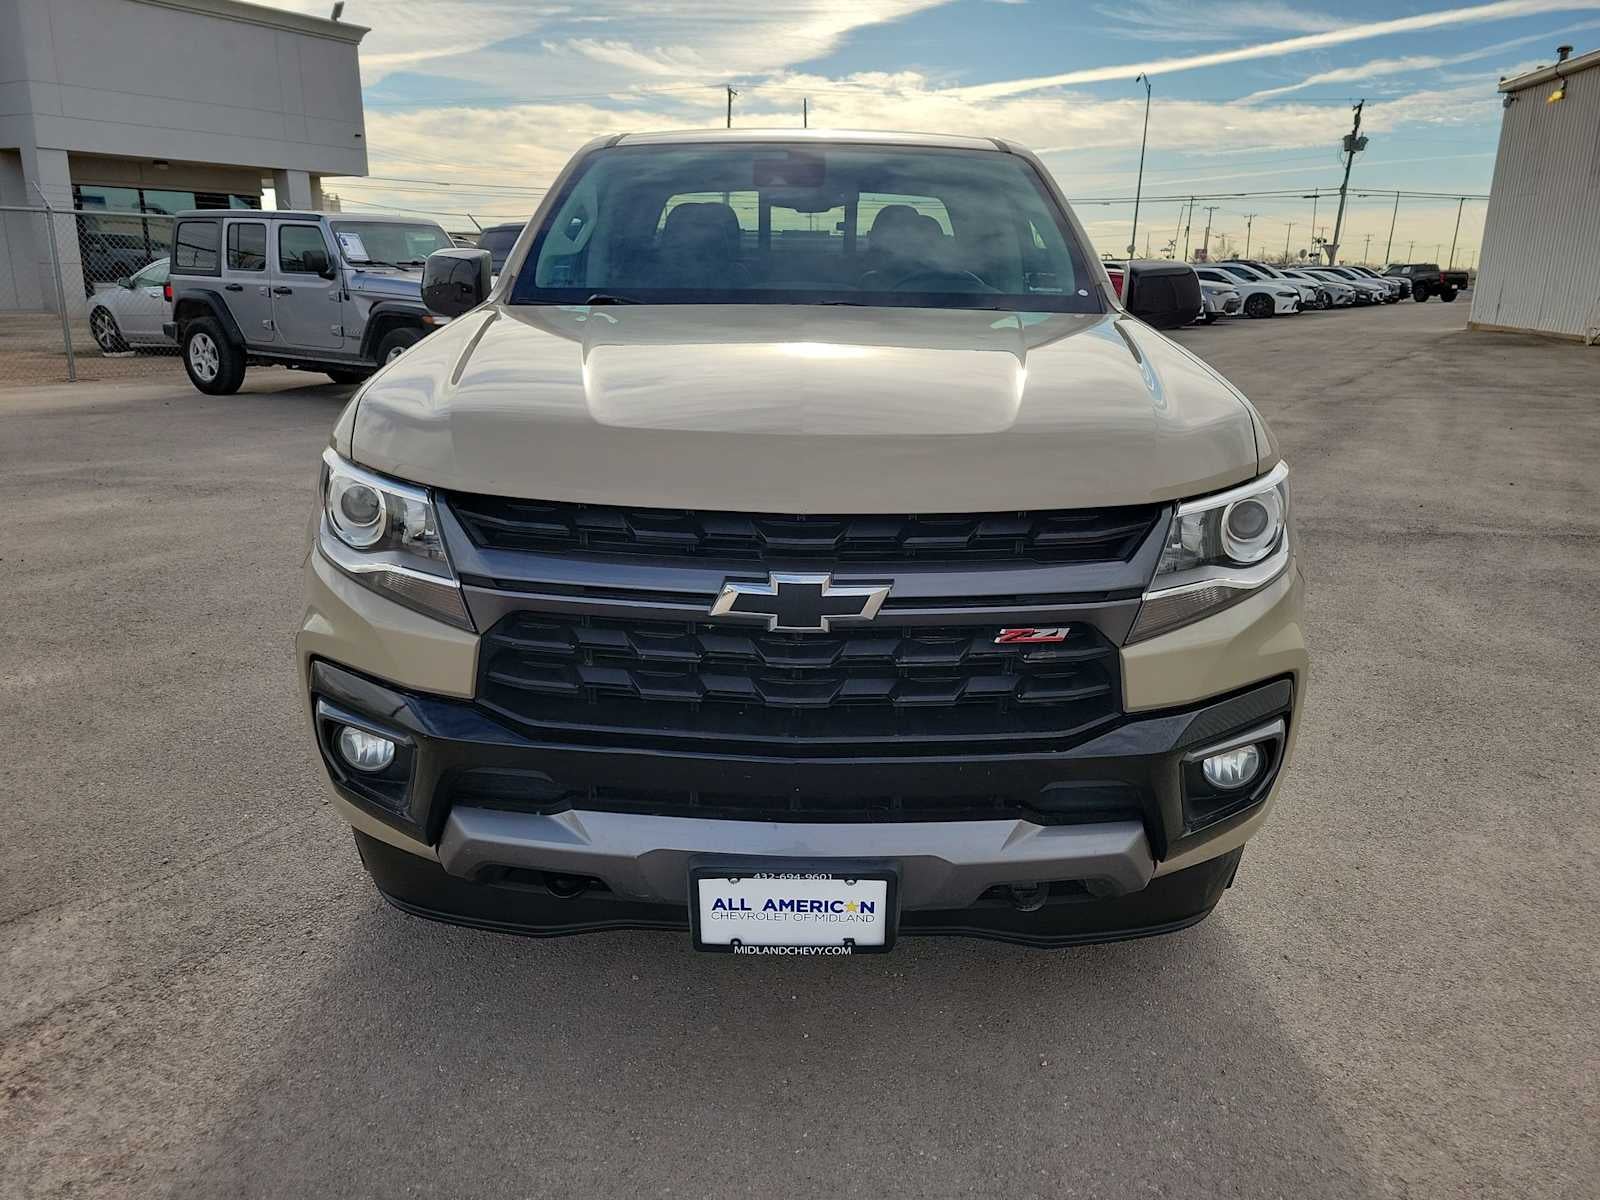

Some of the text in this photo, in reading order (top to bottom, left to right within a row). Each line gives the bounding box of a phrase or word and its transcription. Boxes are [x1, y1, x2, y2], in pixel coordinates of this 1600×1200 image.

[712, 898, 752, 911] ALL
[711, 911, 875, 923] CHEVROLET OF MIDLAND
[734, 946, 852, 955] MIDLANDCHEVY.COM
